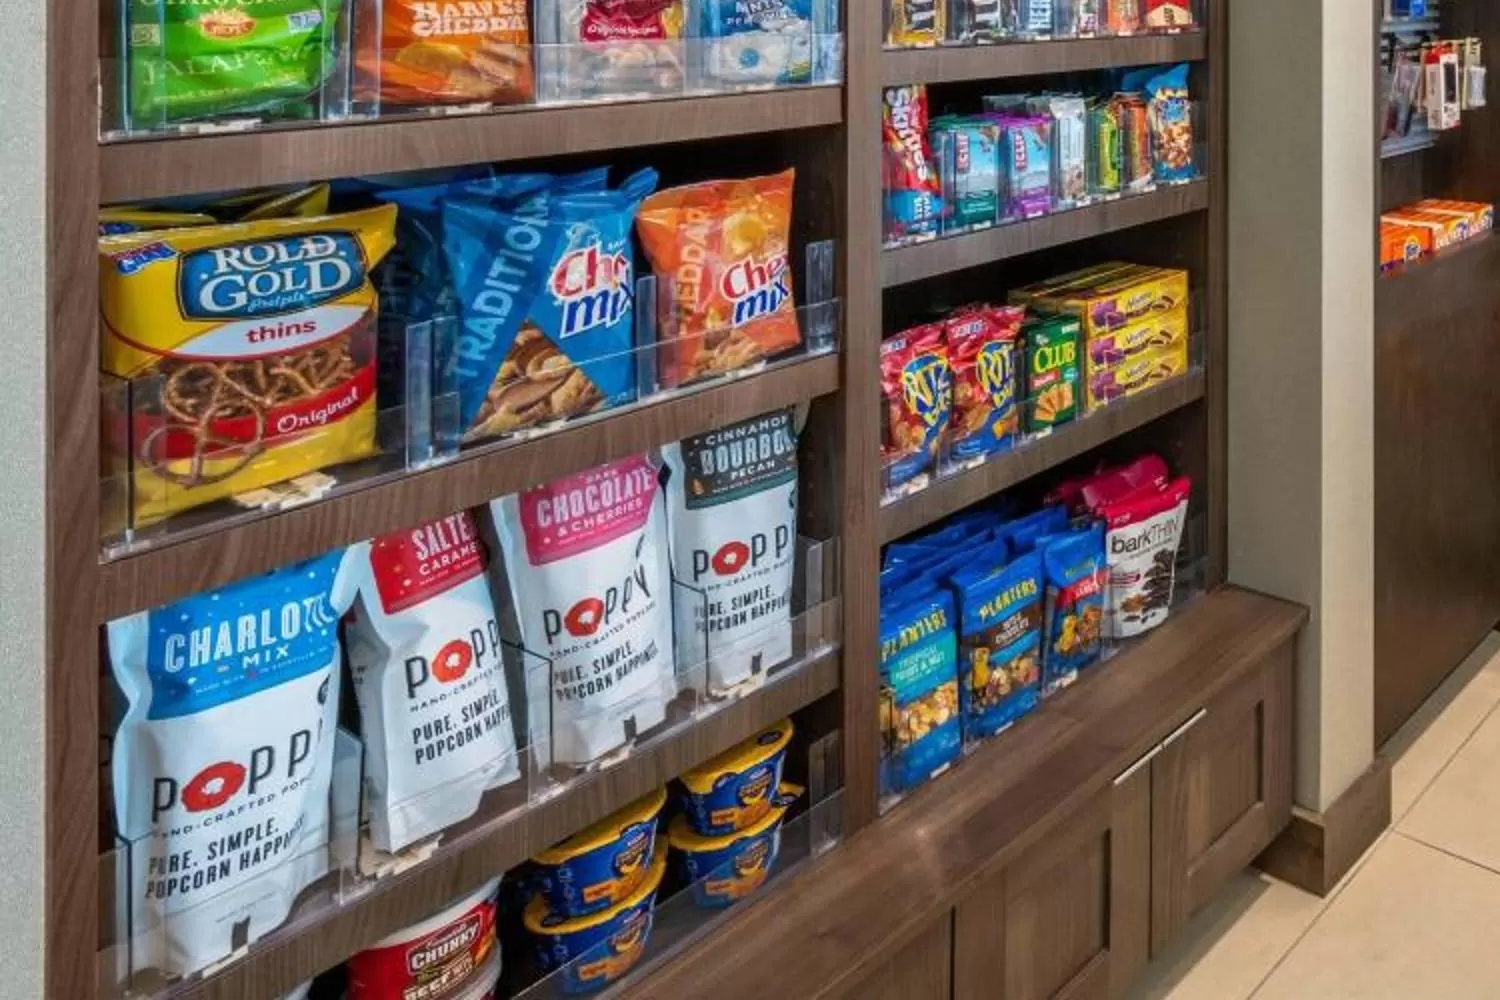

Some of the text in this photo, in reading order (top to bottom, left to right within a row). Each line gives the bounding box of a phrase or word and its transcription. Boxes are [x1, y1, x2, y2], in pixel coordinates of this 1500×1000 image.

[208, 234, 337, 274] ROLD
[199, 257, 351, 313] GOLD
[245, 318, 317, 344] thins
[1033, 341, 1076, 373] CLUB
[276, 386, 359, 433] Original
[536, 466, 656, 529] CHOCOLATE
[571, 497, 643, 532] CHERRIES
[242, 643, 290, 670] MIX
[411, 713, 458, 745] PURE.
[415, 725, 483, 765] POPCORN
[151, 720, 322, 824] POPP
[206, 817, 279, 861] SIMPLE.
[144, 859, 231, 899] POPCORN
[410, 921, 480, 971] CHUNKY
